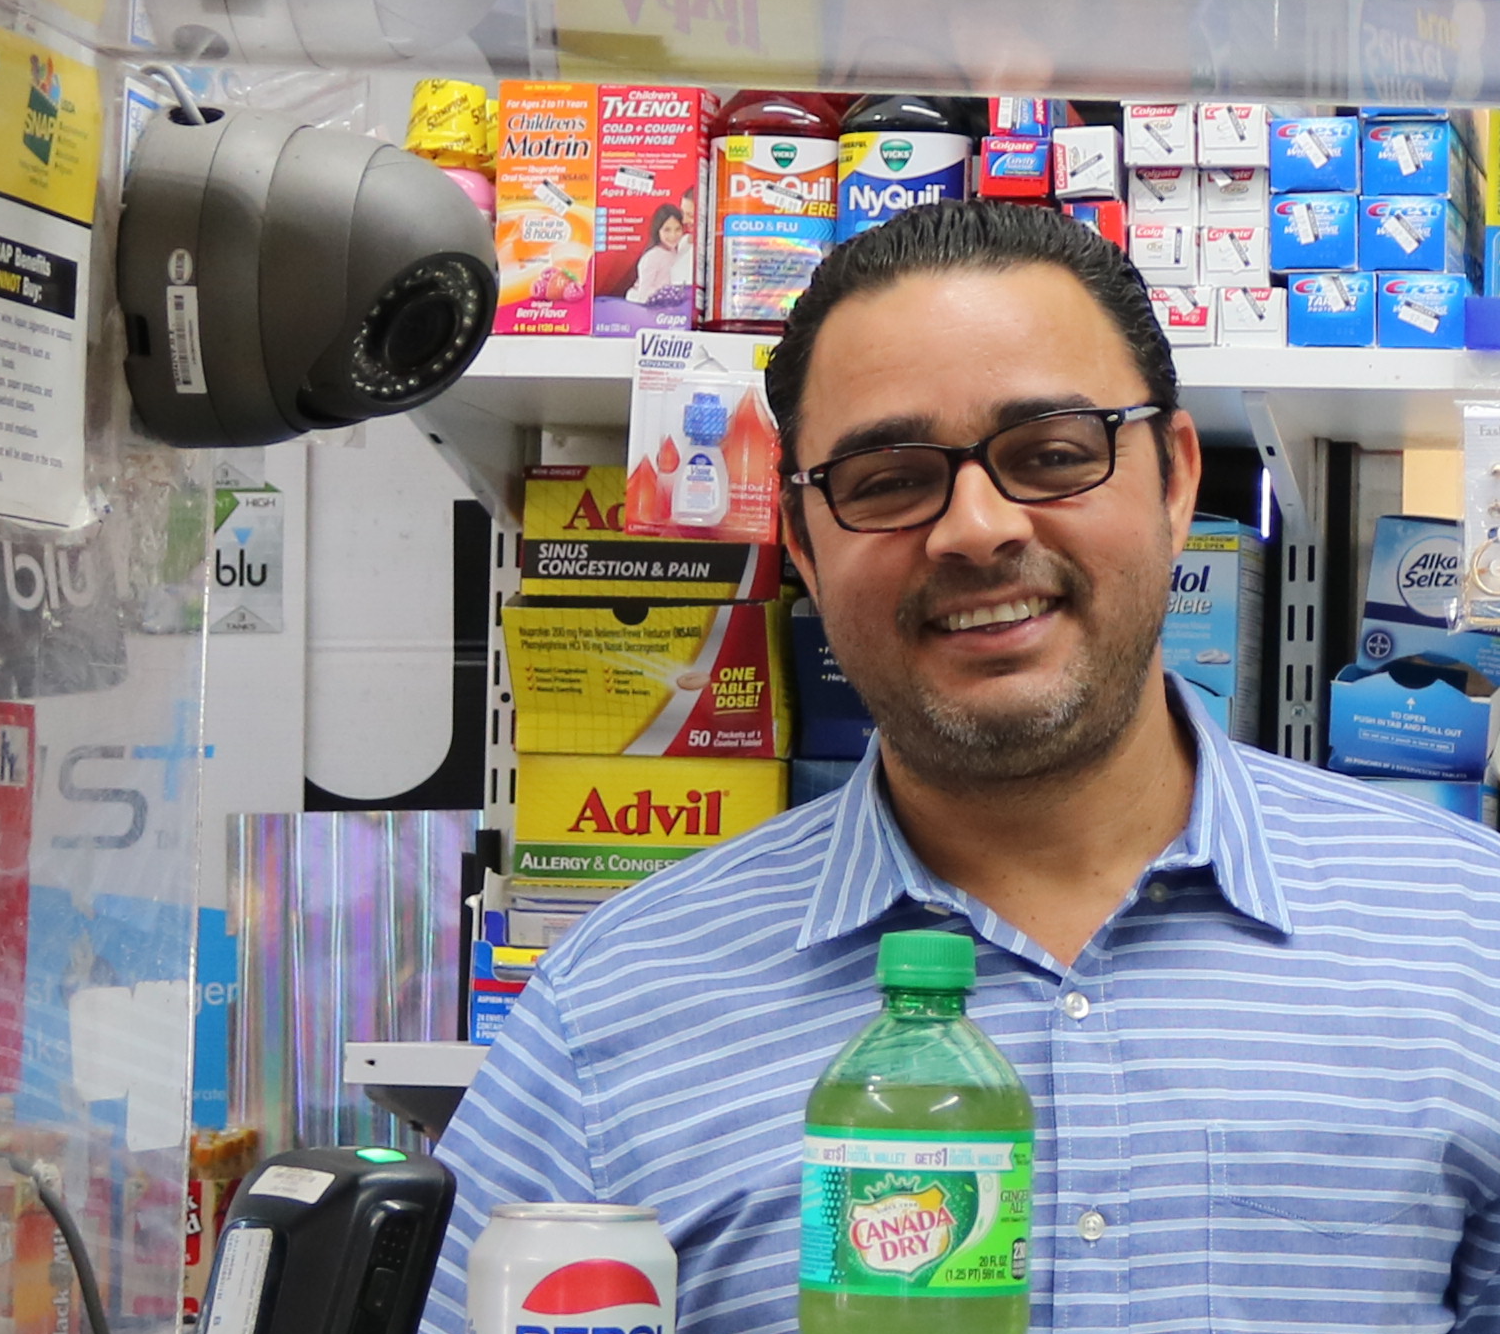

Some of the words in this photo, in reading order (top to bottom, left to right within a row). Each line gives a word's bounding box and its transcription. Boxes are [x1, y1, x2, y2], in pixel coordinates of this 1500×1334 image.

[601, 97, 694, 118] TYLENOL
[505, 114, 587, 135] Children's
[501, 133, 591, 162] Motrin
[641, 329, 693, 362] Visine
[538, 543, 588, 560] SINUS
[538, 559, 649, 577] CONGESTION
[651, 562, 665, 577] &
[667, 562, 710, 578] PAIN
[568, 787, 724, 836] Advil
[852, 1203, 954, 1248] CANADA
[879, 1235, 931, 1263] DRY
